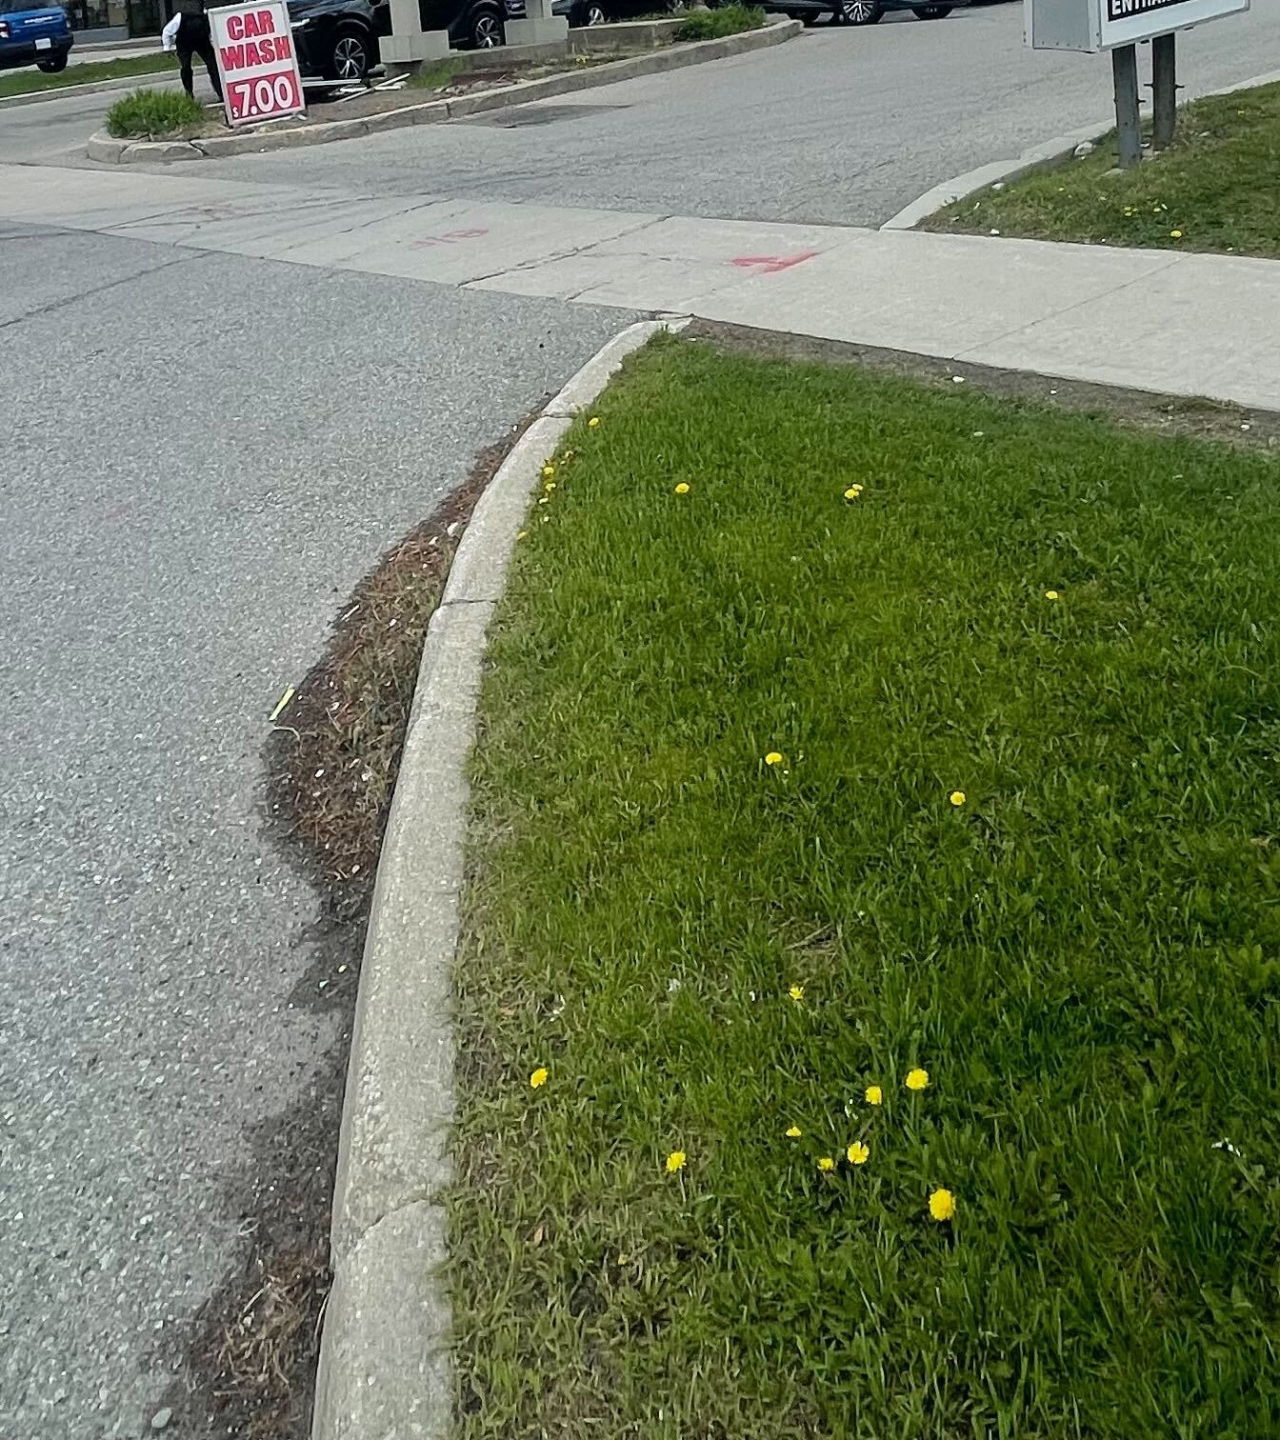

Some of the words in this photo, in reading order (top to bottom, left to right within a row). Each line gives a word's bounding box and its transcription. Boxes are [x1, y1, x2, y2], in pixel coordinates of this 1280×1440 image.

[226, 9, 275, 40] CAR
[220, 35, 292, 71] WASH
[233, 75, 293, 118] $7.00
